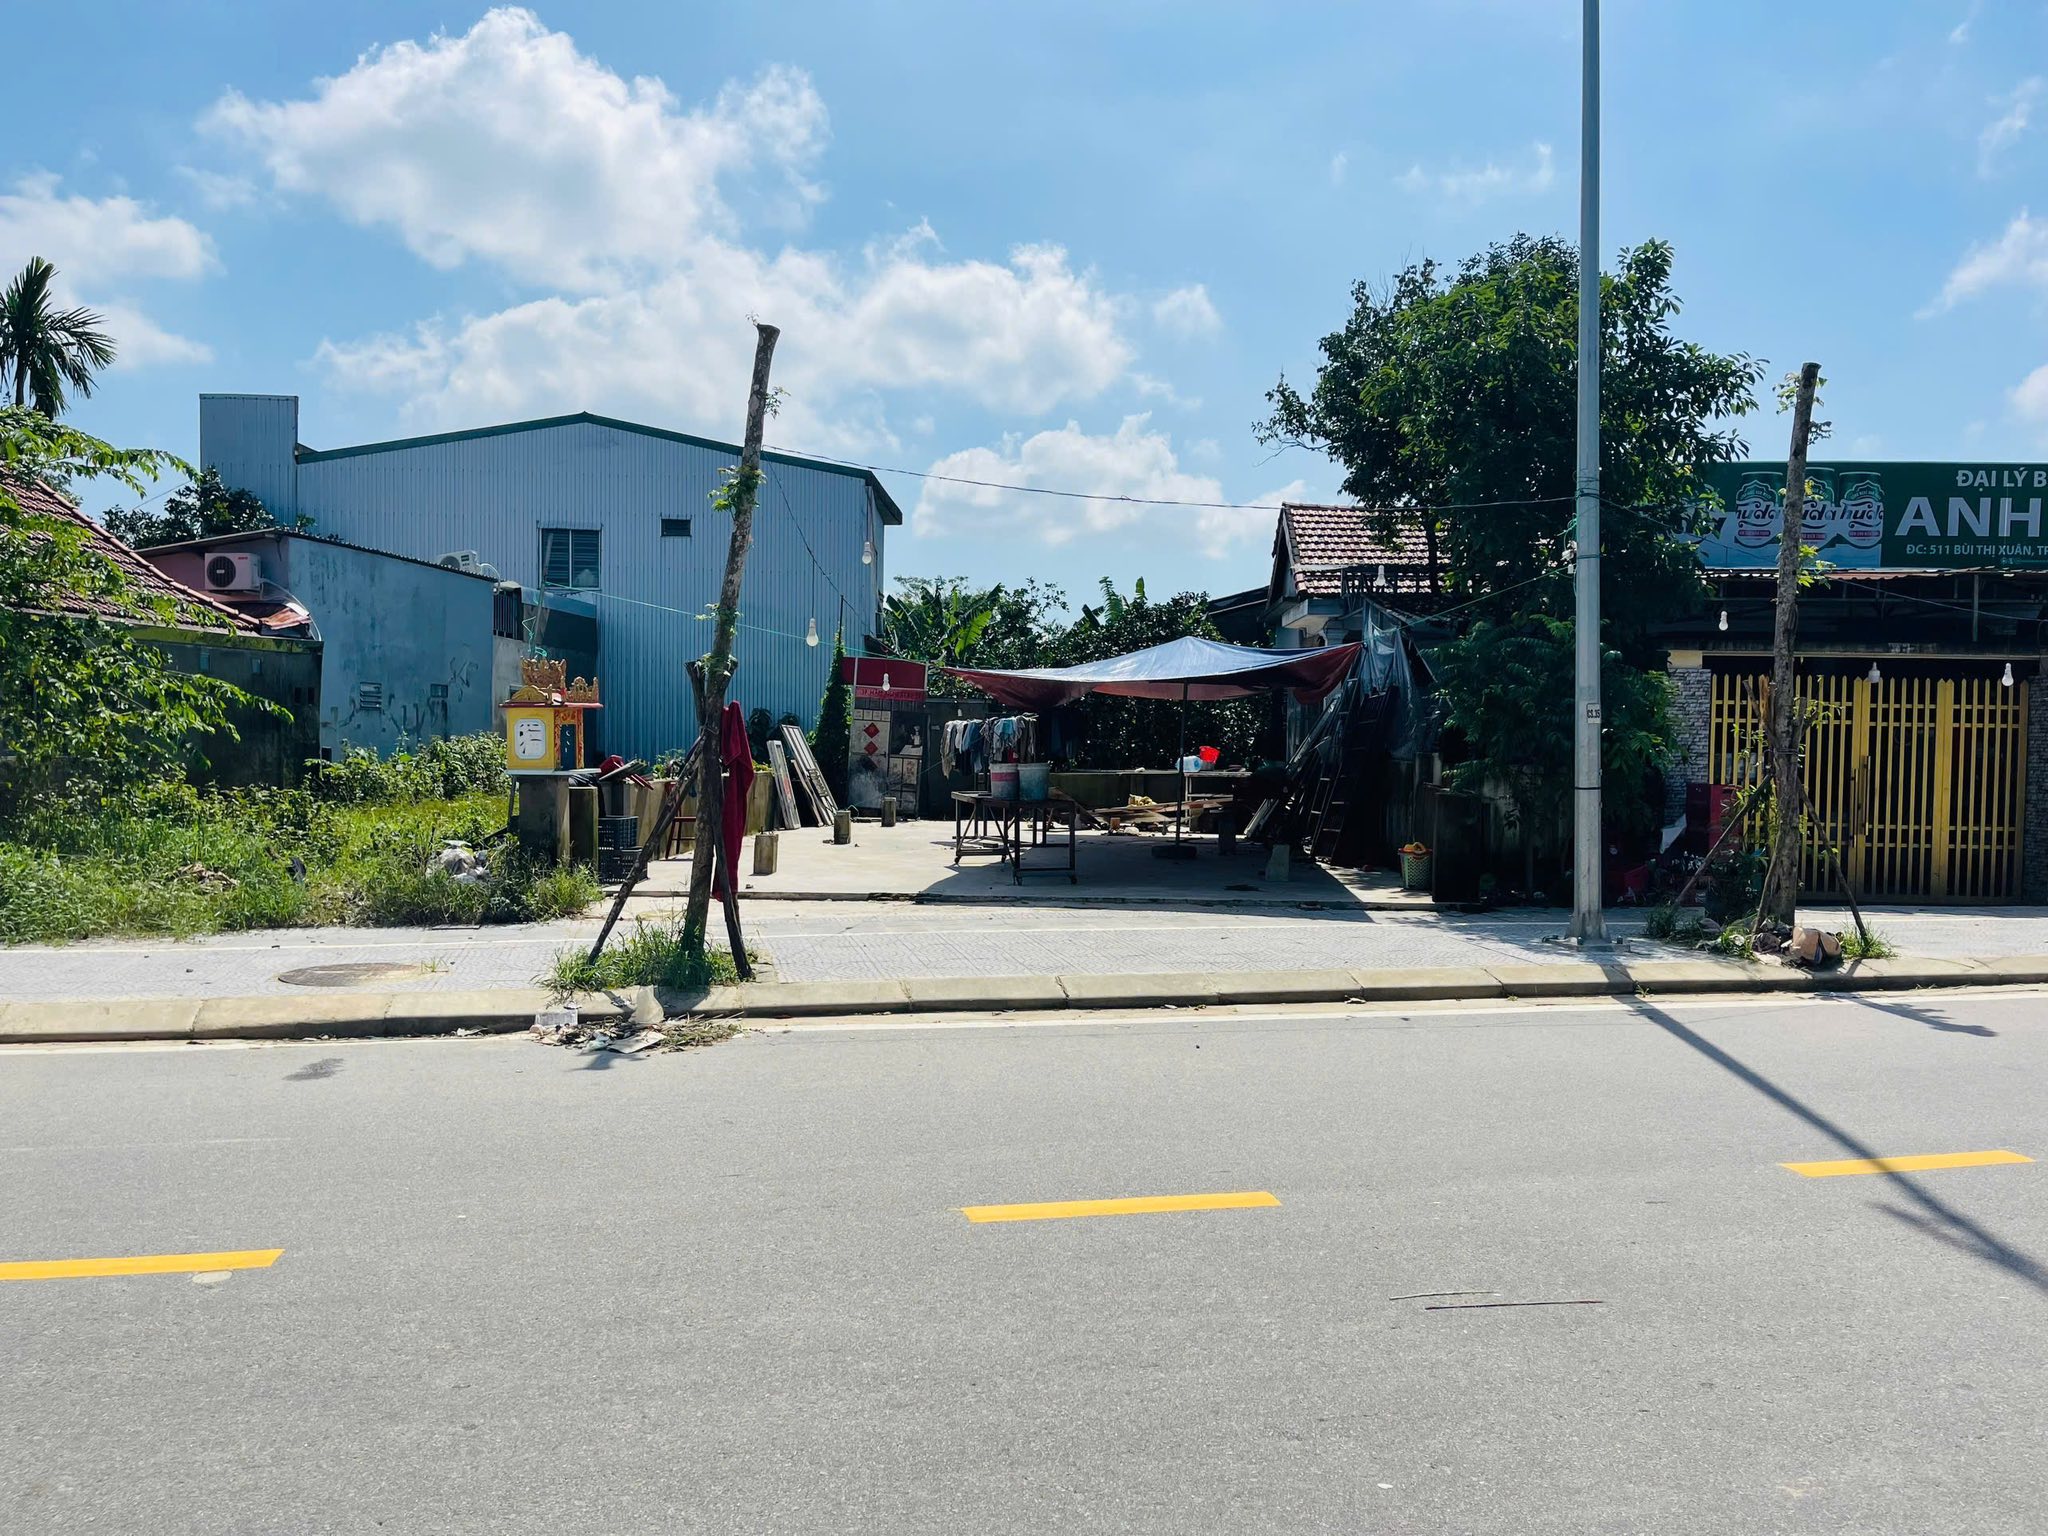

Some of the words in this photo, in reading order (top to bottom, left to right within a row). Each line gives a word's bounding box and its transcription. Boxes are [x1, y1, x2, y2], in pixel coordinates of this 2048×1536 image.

[1956, 470, 1996, 492] ĐẠI
[2003, 467, 2028, 487] LÝ
[1894, 496, 2042, 537] ANH
[1906, 544, 1927, 555] ĐC:
[1929, 544, 1950, 555] 511
[1954, 543, 1974, 555] BÙI
[1976, 545, 1996, 558] THỊ
[1998, 543, 2035, 557] XUÂN,
